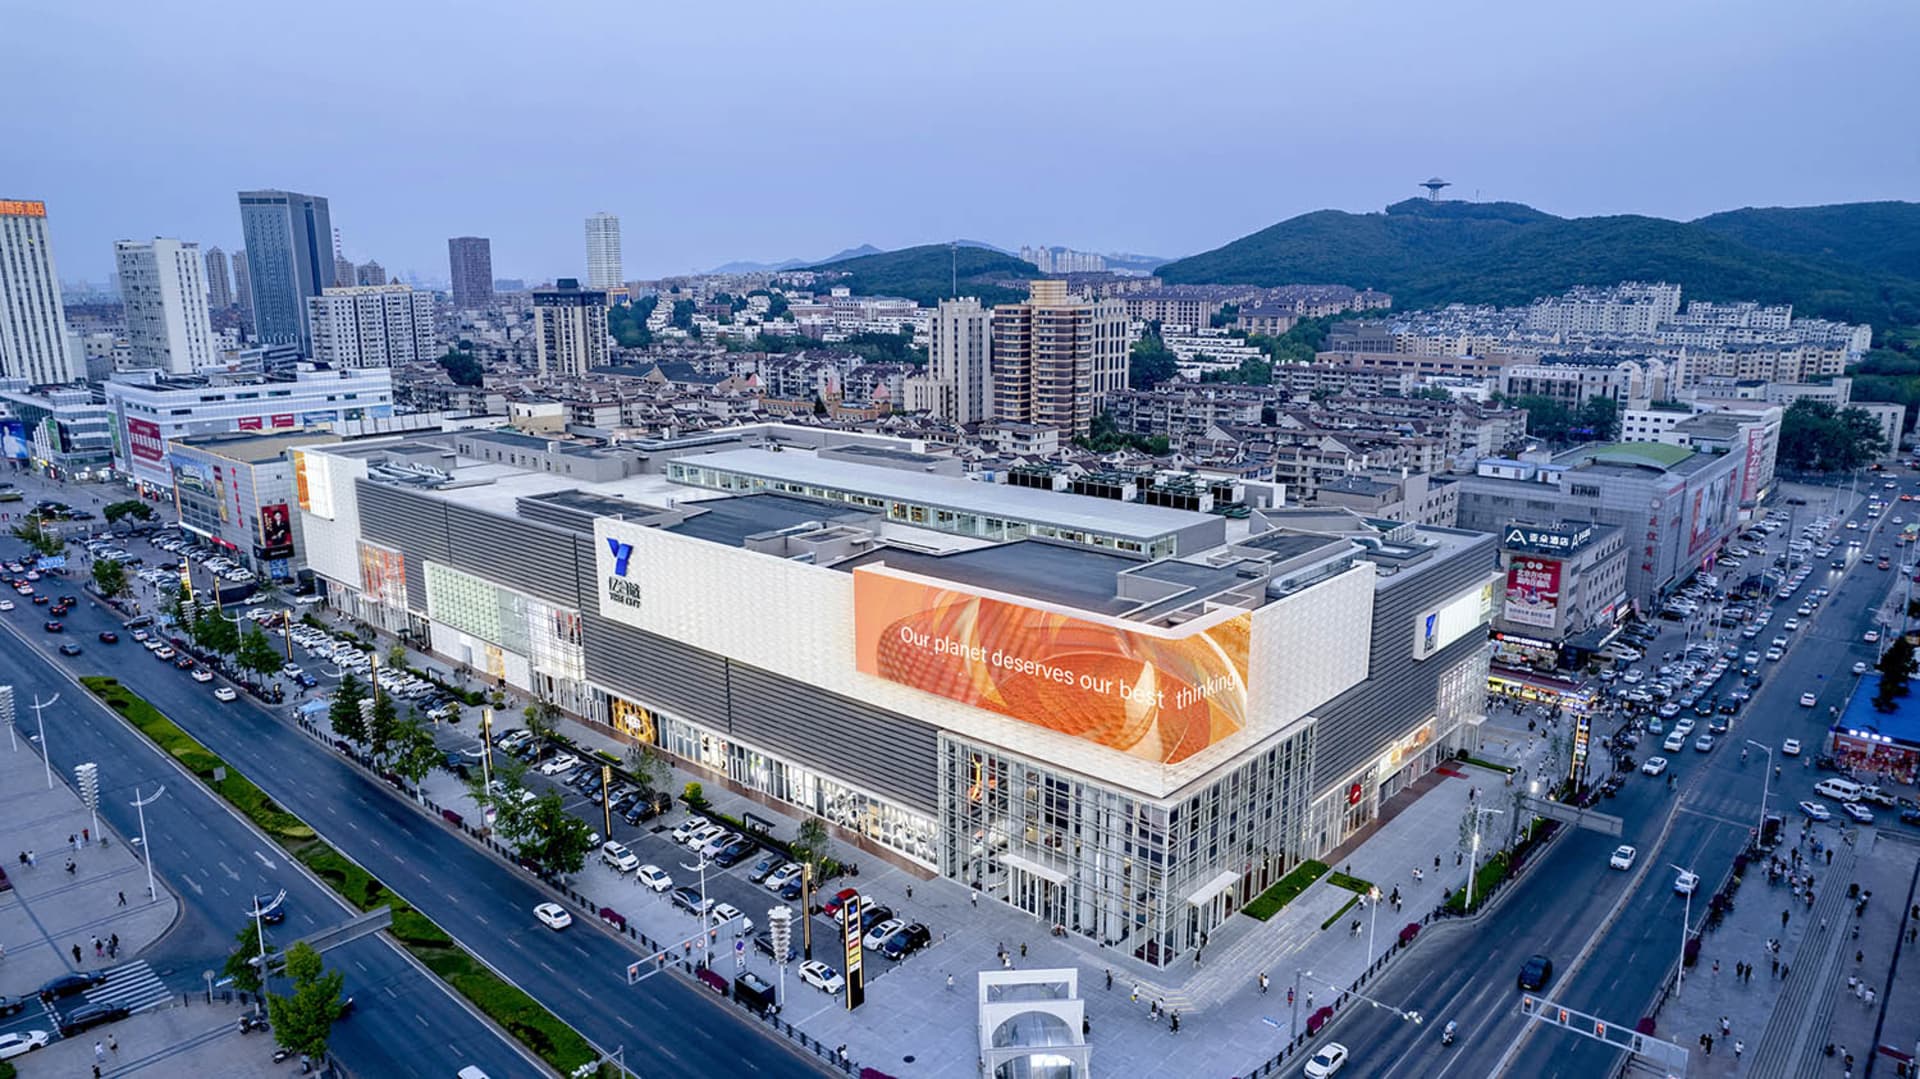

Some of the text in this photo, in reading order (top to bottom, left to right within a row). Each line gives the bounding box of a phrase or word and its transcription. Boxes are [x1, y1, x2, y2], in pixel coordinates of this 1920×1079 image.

[1529, 532, 1569, 546] 亚朵酒店
[901, 626, 1236, 710] Our planet deserves our best thinking
